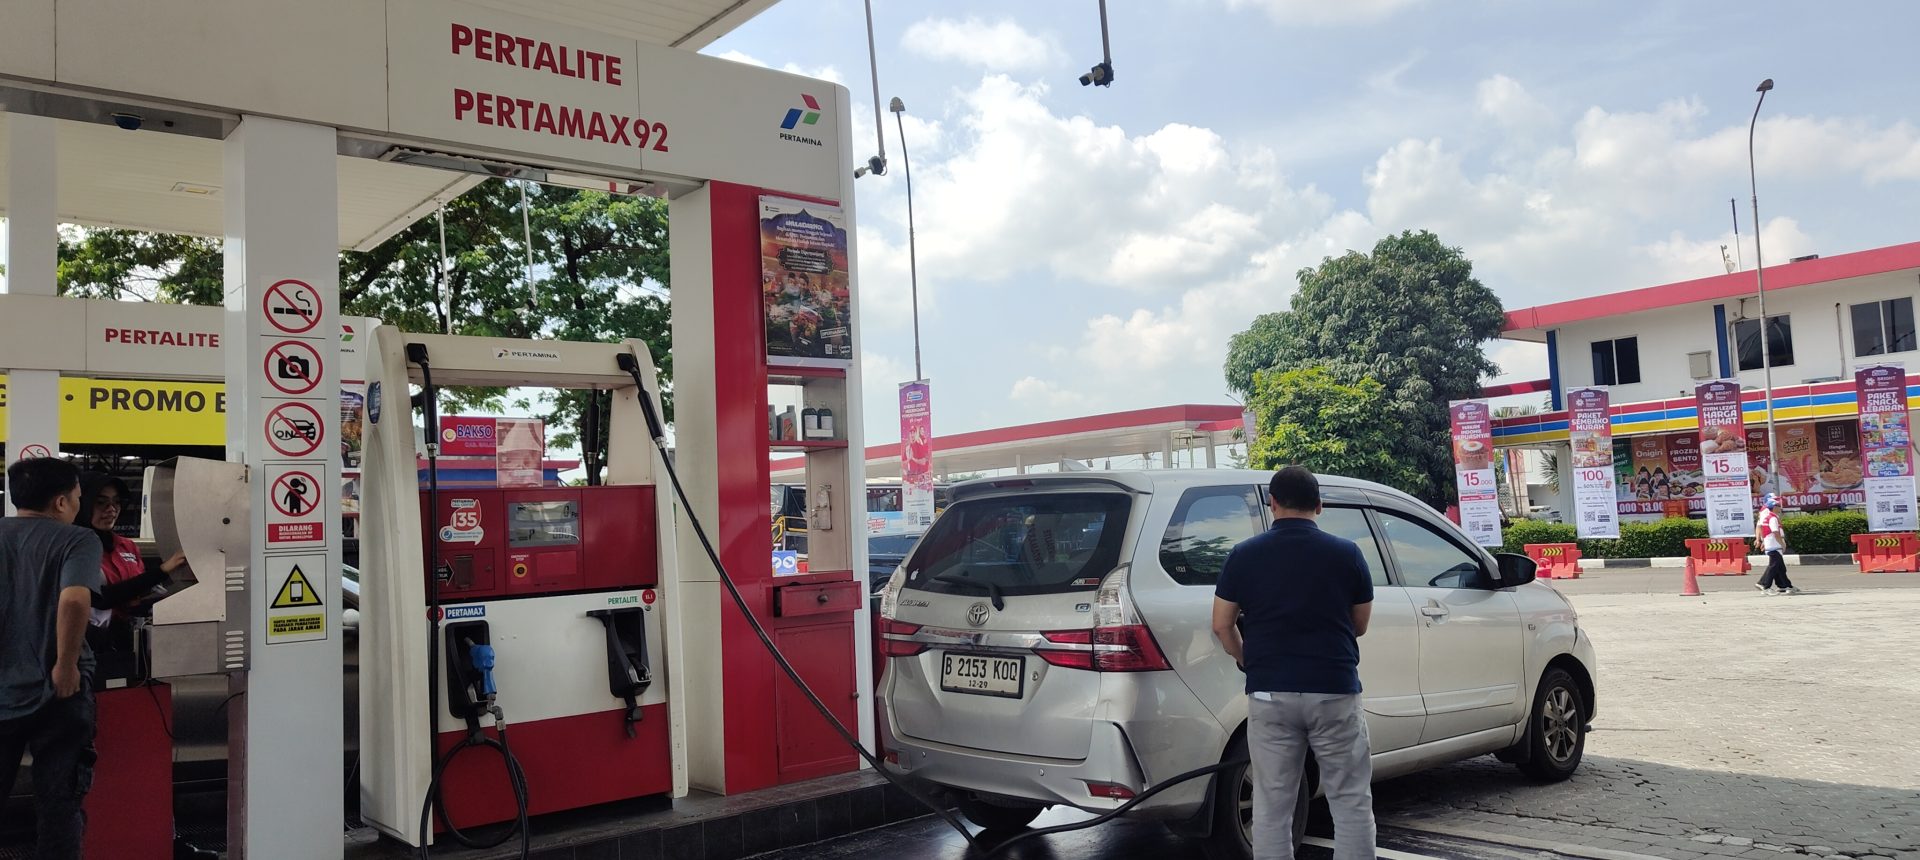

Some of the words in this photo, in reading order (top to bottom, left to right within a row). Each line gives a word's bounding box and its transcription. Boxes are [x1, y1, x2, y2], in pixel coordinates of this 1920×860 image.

[451, 22, 622, 86] PERTALITE
[780, 132, 822, 146] PERTAMINA
[105, 328, 220, 348] PERTALITE
[90, 387, 206, 413] PROMO
[1868, 392, 1898, 400] PAKET
[1862, 404, 1904, 412] LEBARAN
[1704, 410, 1737, 418] HARGA
[1704, 417, 1738, 426] HEMAT
[276, 430, 294, 439] ON
[457, 424, 492, 438] BAKSO
[1783, 437, 1810, 447] SOSIS
[1636, 450, 1663, 458] Onigiri
[1618, 502, 1636, 512] .000
[1688, 500, 1706, 510] 000
[453, 512, 477, 527] 135
[608, 596, 638, 604] PERTALITE
[448, 608, 484, 618] PERTAMAX
[946, 657, 952, 676] B
[958, 658, 988, 678] 2153
[994, 660, 1018, 681] KOQ
[968, 680, 988, 688] 12-29
